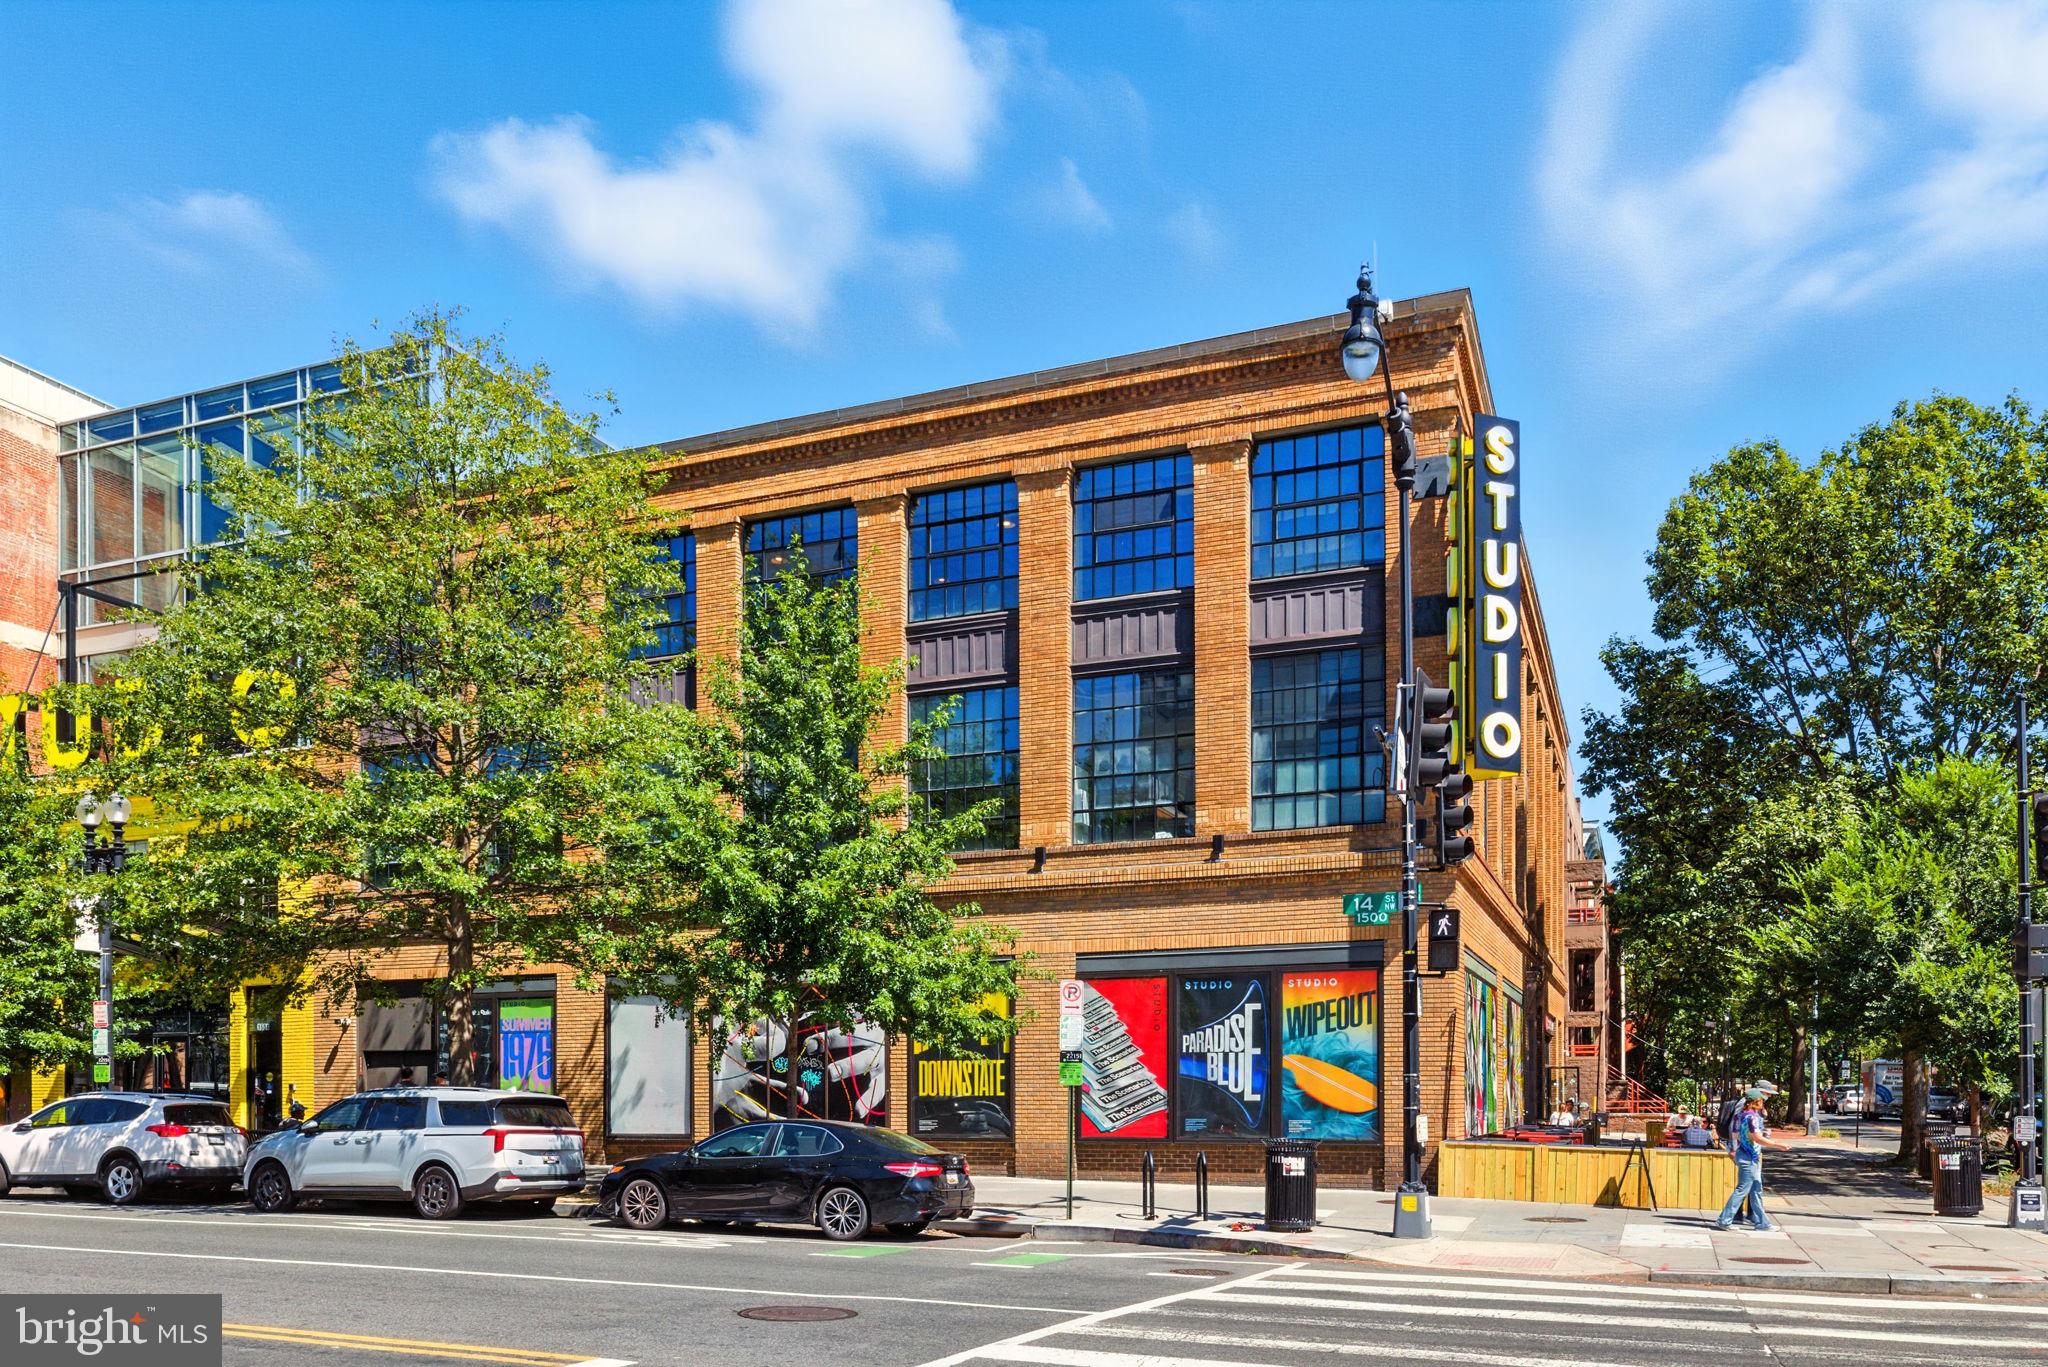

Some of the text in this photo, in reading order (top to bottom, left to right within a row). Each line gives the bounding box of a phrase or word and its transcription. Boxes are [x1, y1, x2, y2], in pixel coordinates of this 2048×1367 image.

[1482, 424, 1521, 759] STUDIO
[1353, 894, 1395, 911] 14 St
[1384, 902, 1395, 910] NW
[1357, 912, 1388, 923] 1500
[1185, 980, 1232, 990] STUDIO
[1288, 977, 1337, 988] STUDIO
[1153, 984, 1161, 1031] STUDIO
[1286, 990, 1376, 1041] WIPEOUT
[502, 1018, 551, 1031] SUMMER
[1182, 1003, 1261, 1054] PARADISE
[502, 1033, 552, 1081] 1976
[1094, 1045, 1138, 1069] The Scenarios
[919, 1060, 1005, 1096] DOWNSTATE
[1097, 1063, 1143, 1085] The Scenarios
[1206, 1050, 1261, 1101] BLUE
[1100, 1079, 1151, 1103] The Scenarios
[1107, 1093, 1164, 1121] The Scenarios
